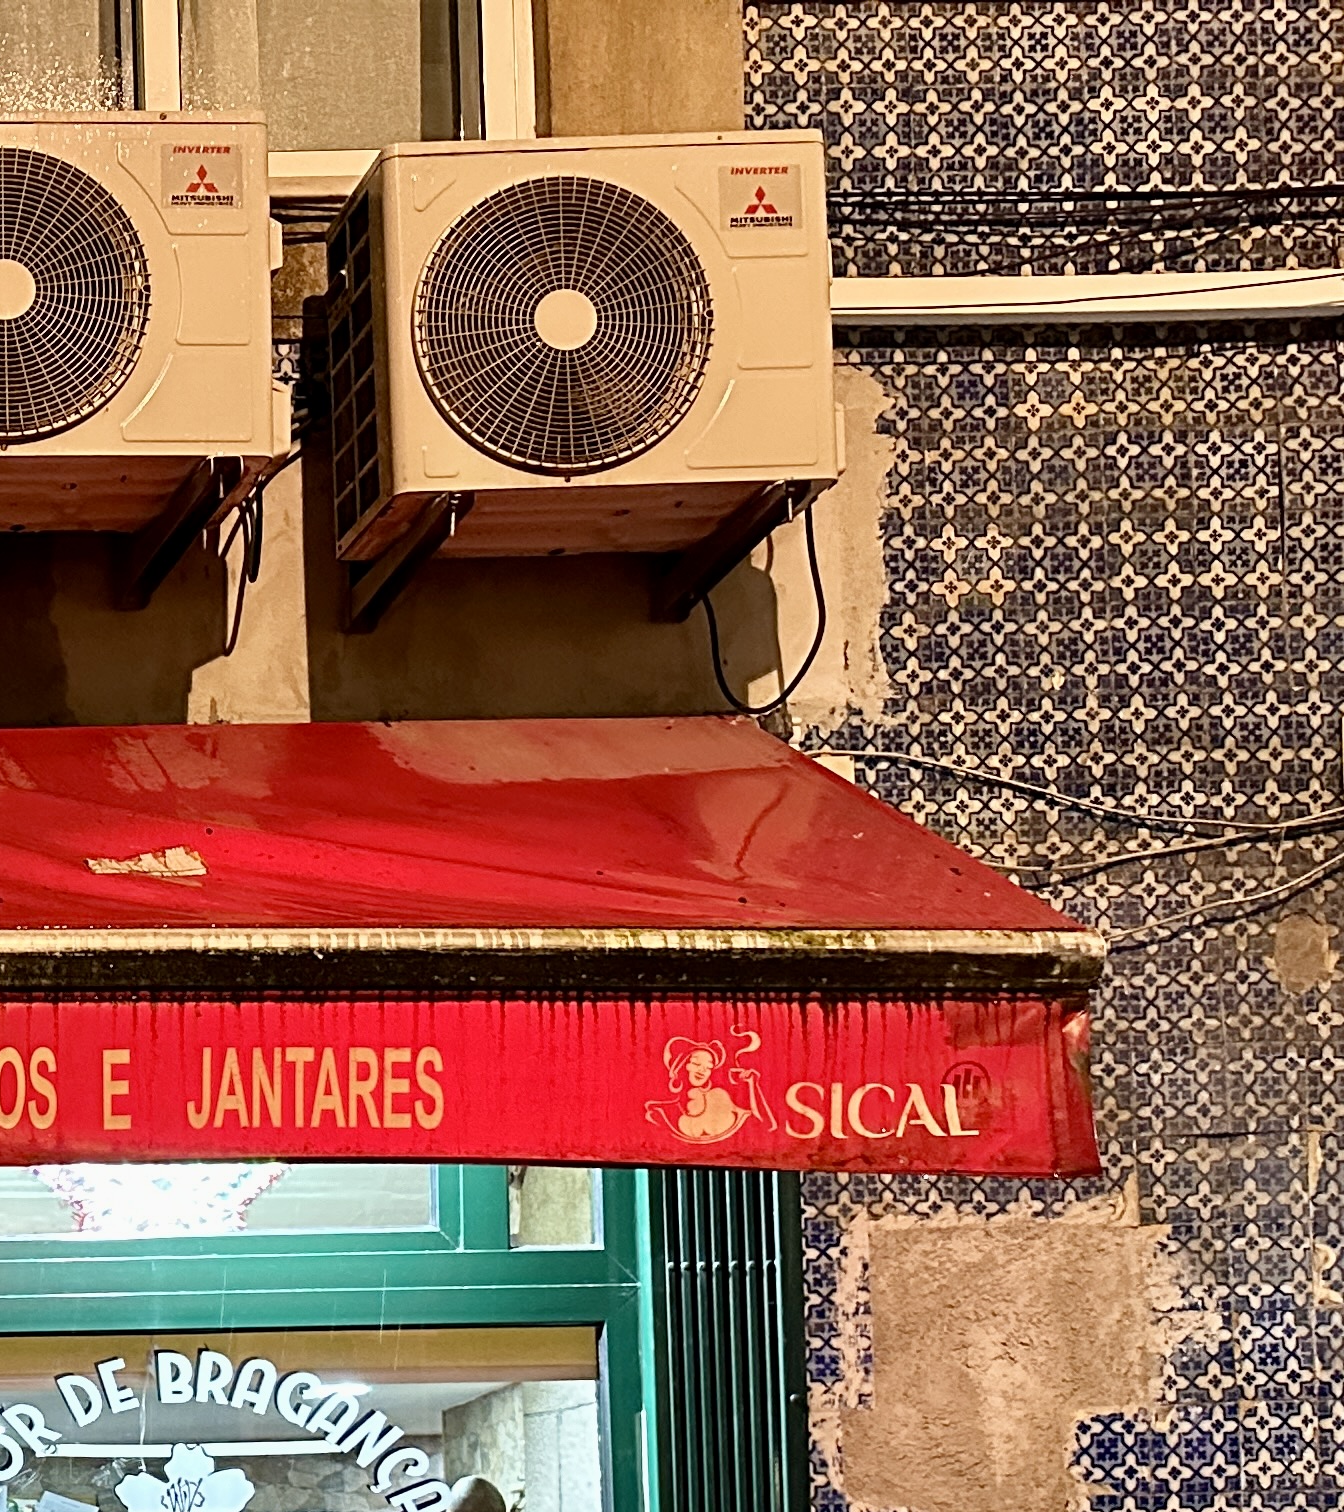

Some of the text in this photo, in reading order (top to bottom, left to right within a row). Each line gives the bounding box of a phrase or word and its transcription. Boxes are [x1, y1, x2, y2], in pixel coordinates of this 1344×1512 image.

[172, 145, 232, 155] INVERTER
[730, 166, 789, 176] INVERTER
[171, 194, 234, 202] MITSUBISHI
[730, 215, 793, 224] MITSUBISHI
[102, 1048, 133, 1130] E
[186, 1046, 445, 1130] JANTARES
[785, 1081, 980, 1139] SICAL
[53, 1356, 140, 1427] DE
